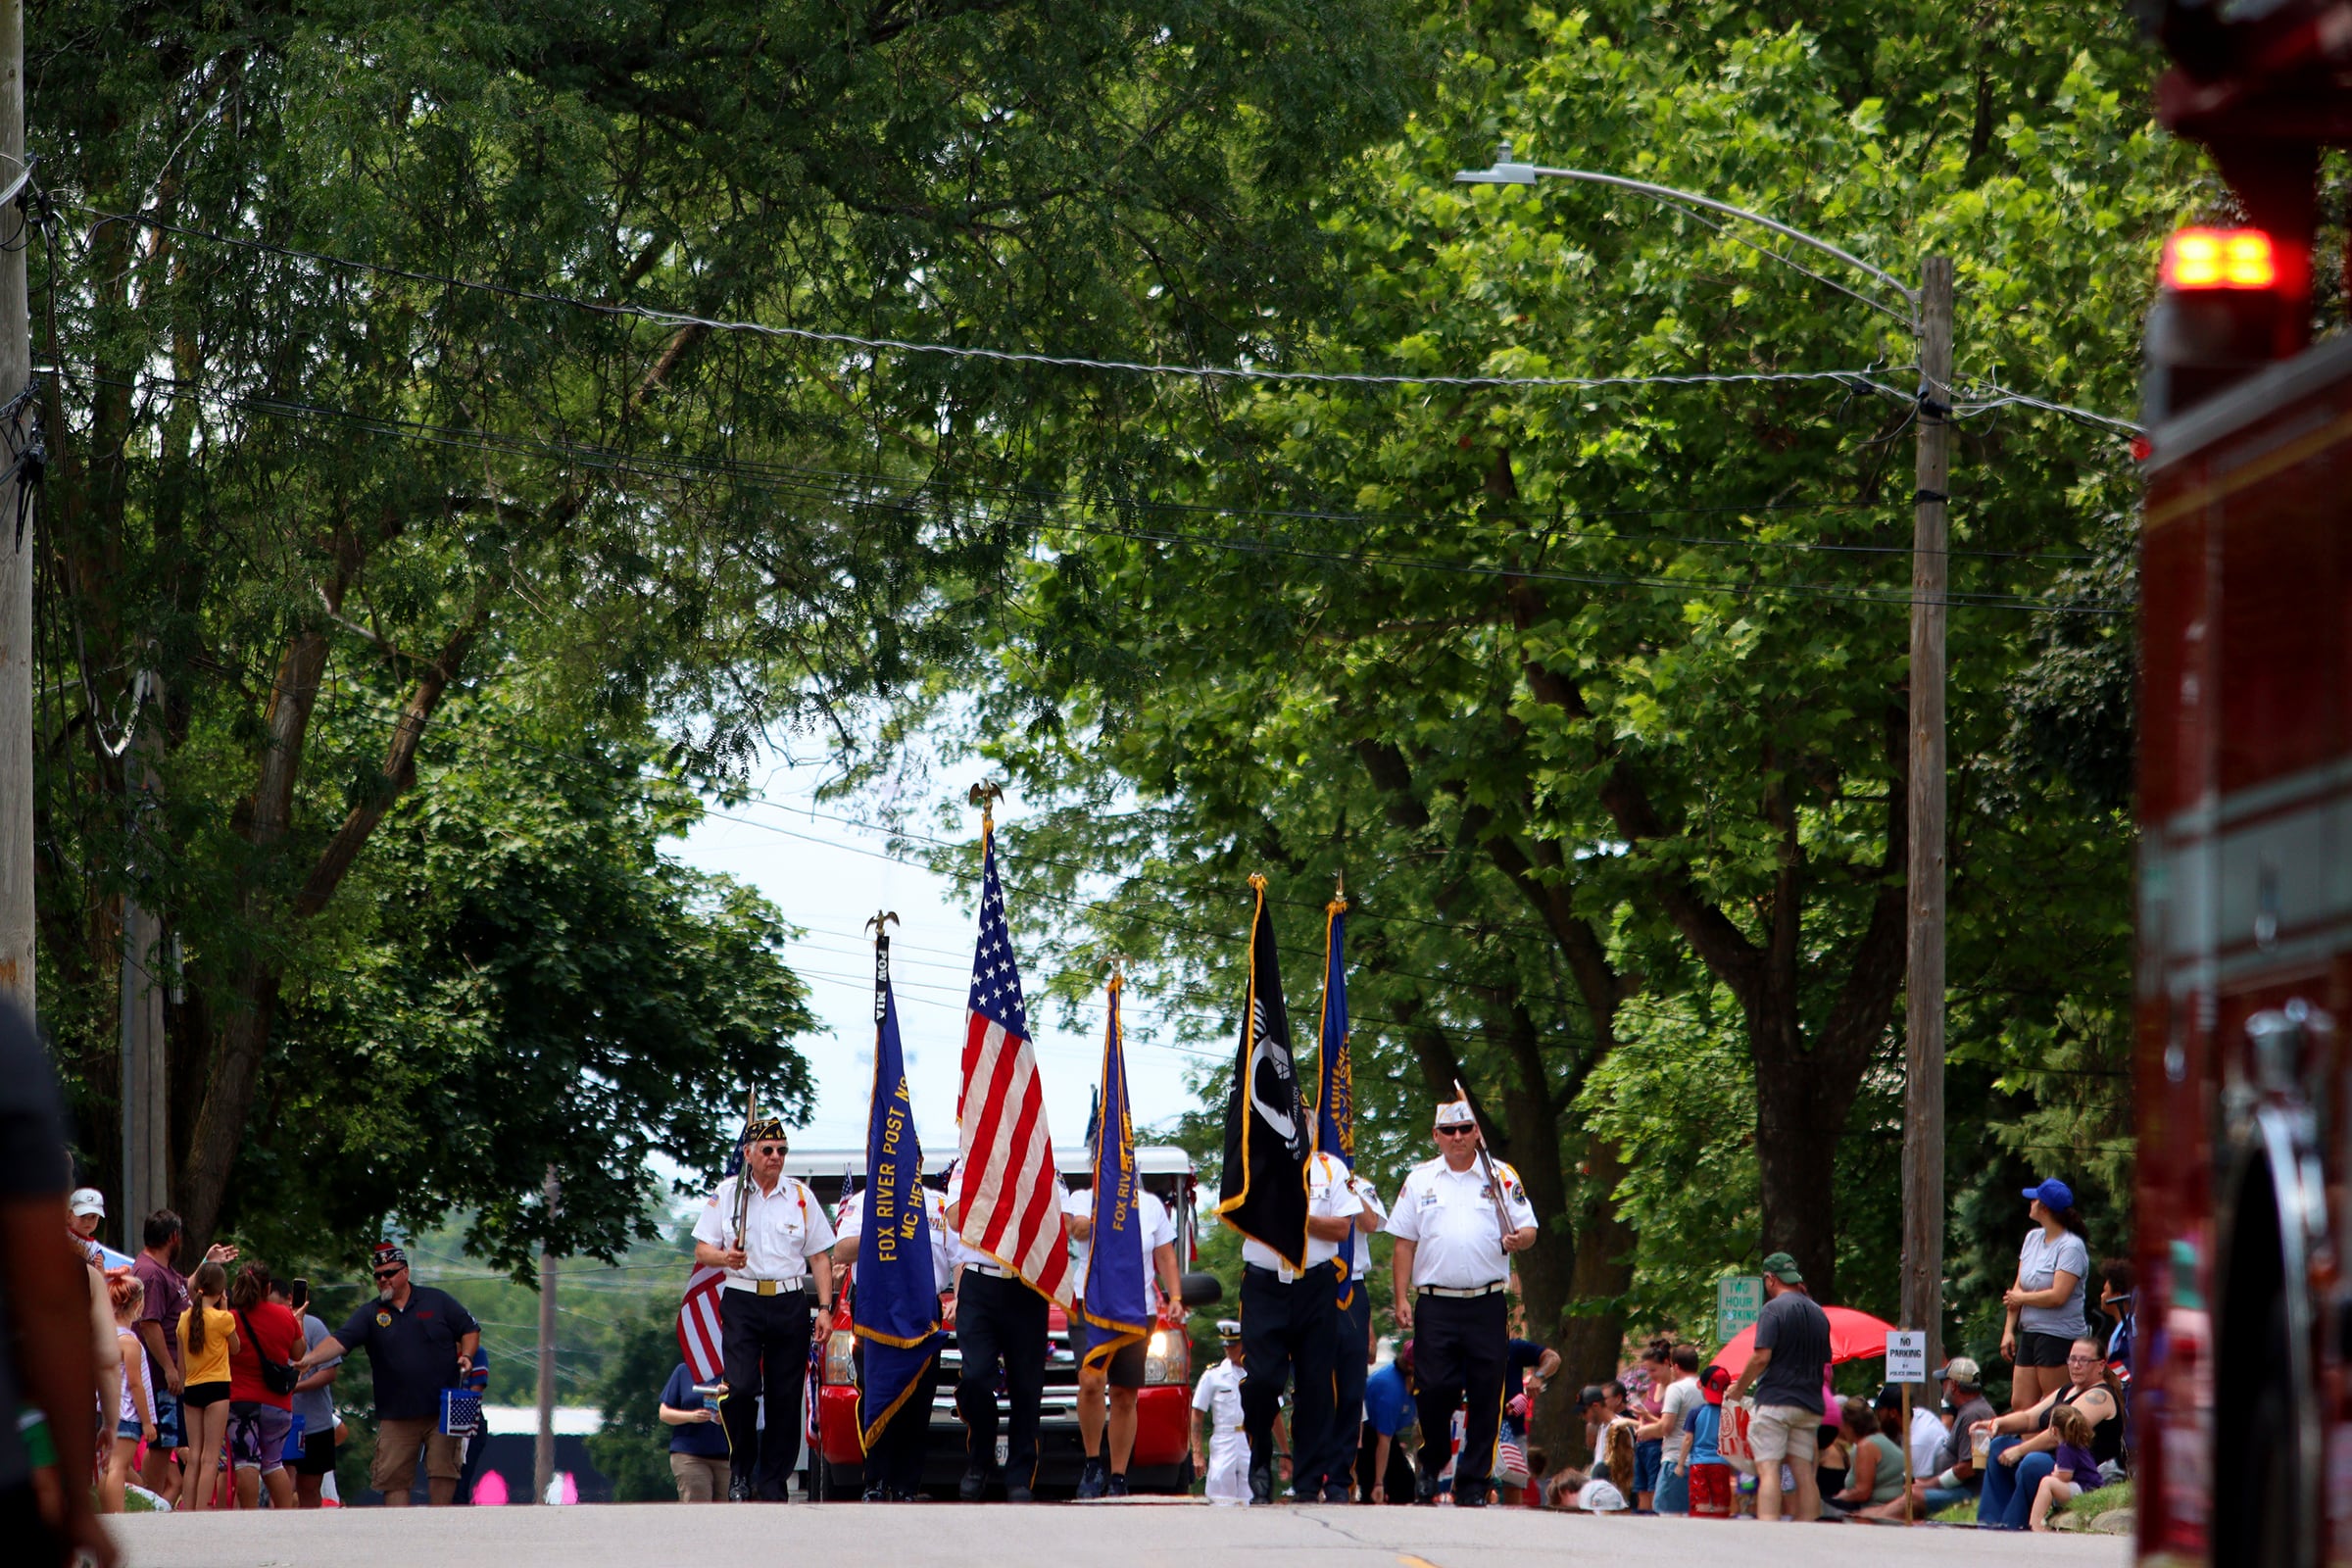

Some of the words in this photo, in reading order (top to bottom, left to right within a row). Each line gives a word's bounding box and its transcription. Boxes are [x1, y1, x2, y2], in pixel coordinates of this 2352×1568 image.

[877, 950, 888, 982] POW
[876, 991, 886, 1020] MIA
[883, 1105, 906, 1155] POST
[876, 1162, 896, 1218] RIVER
[900, 1212, 919, 1240] MC
[1112, 1200, 1128, 1232] FOX
[877, 1227, 898, 1262] FOX
[1722, 1309, 1757, 1321] PRKING
[1726, 1297, 1753, 1307] HOUR
[1889, 1349, 1922, 1358] PARKING
[1900, 1338, 1911, 1347] NO
